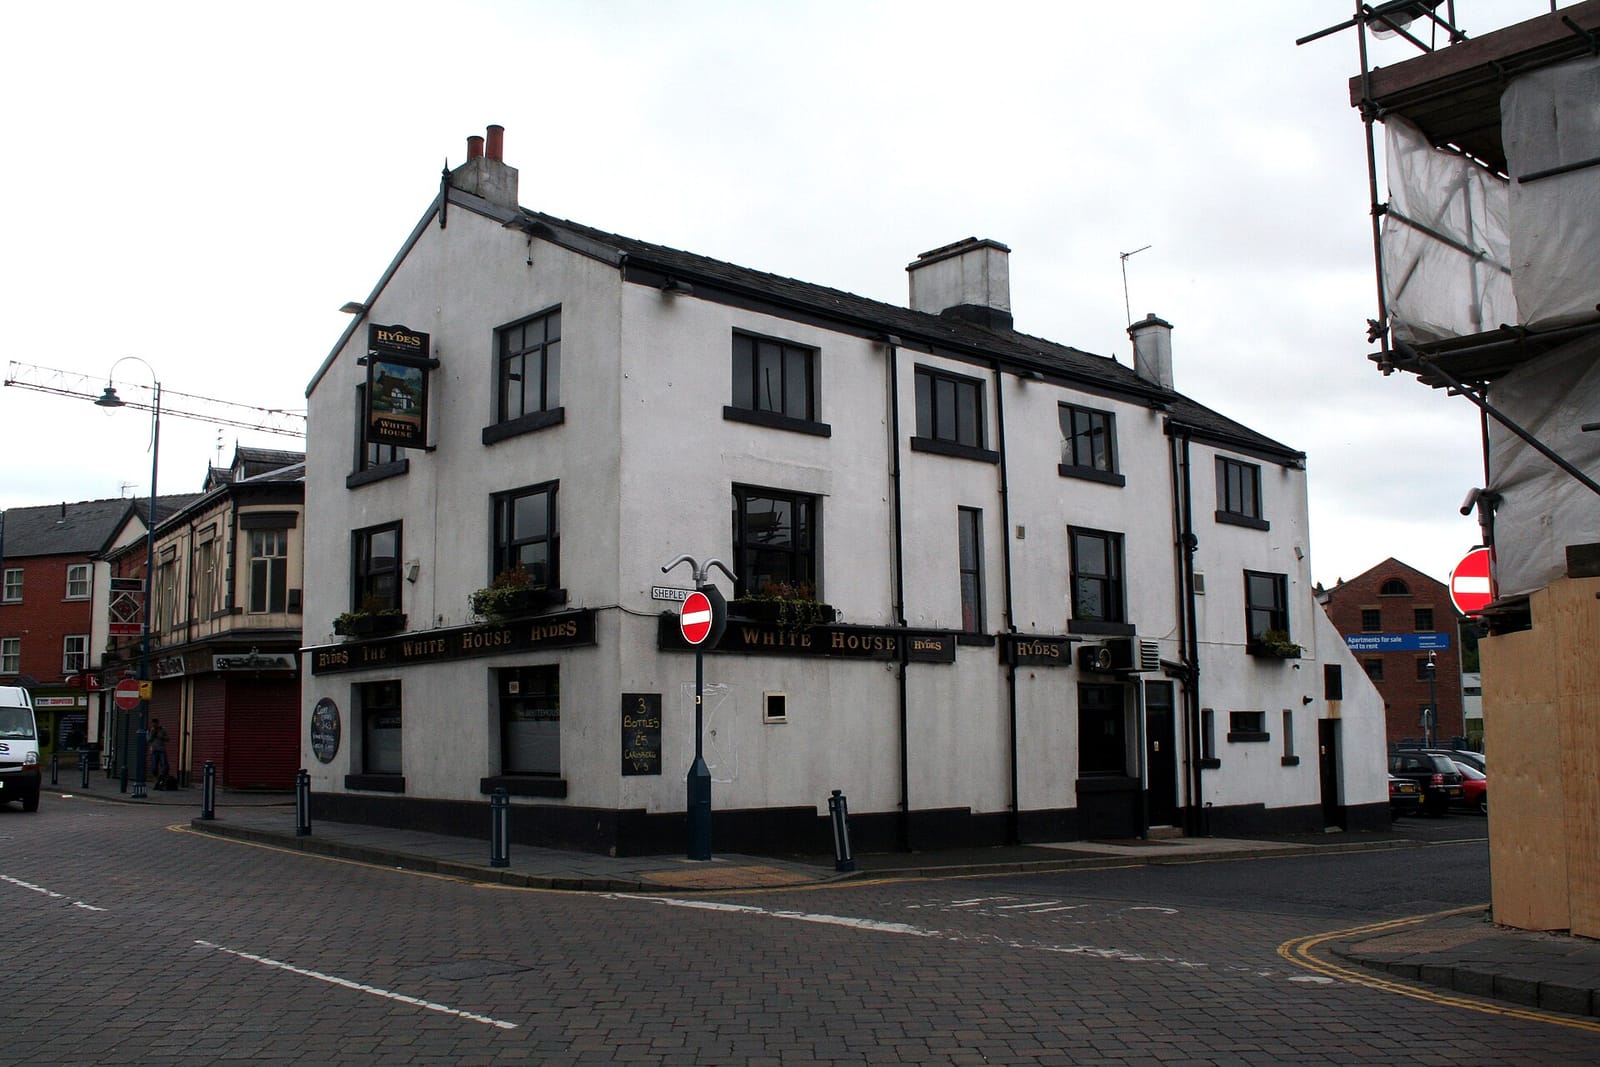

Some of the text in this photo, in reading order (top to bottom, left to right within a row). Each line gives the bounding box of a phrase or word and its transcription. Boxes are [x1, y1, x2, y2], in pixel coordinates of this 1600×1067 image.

[377, 330, 421, 346] HYDES
[380, 420, 412, 432] WHITE
[380, 428, 412, 438] HOUSE
[654, 588, 688, 600] SHEPLEY
[363, 646, 387, 661] THE
[403, 639, 446, 657] WHITE
[462, 630, 512, 649] HOUSE
[530, 620, 577, 641] HYDES
[742, 627, 896, 651] WHITE HOUSE
[913, 638, 942, 651] HYDES
[1017, 640, 1060, 658] HYDES
[636, 697, 647, 714] 3
[623, 715, 660, 729] BOTTLES
